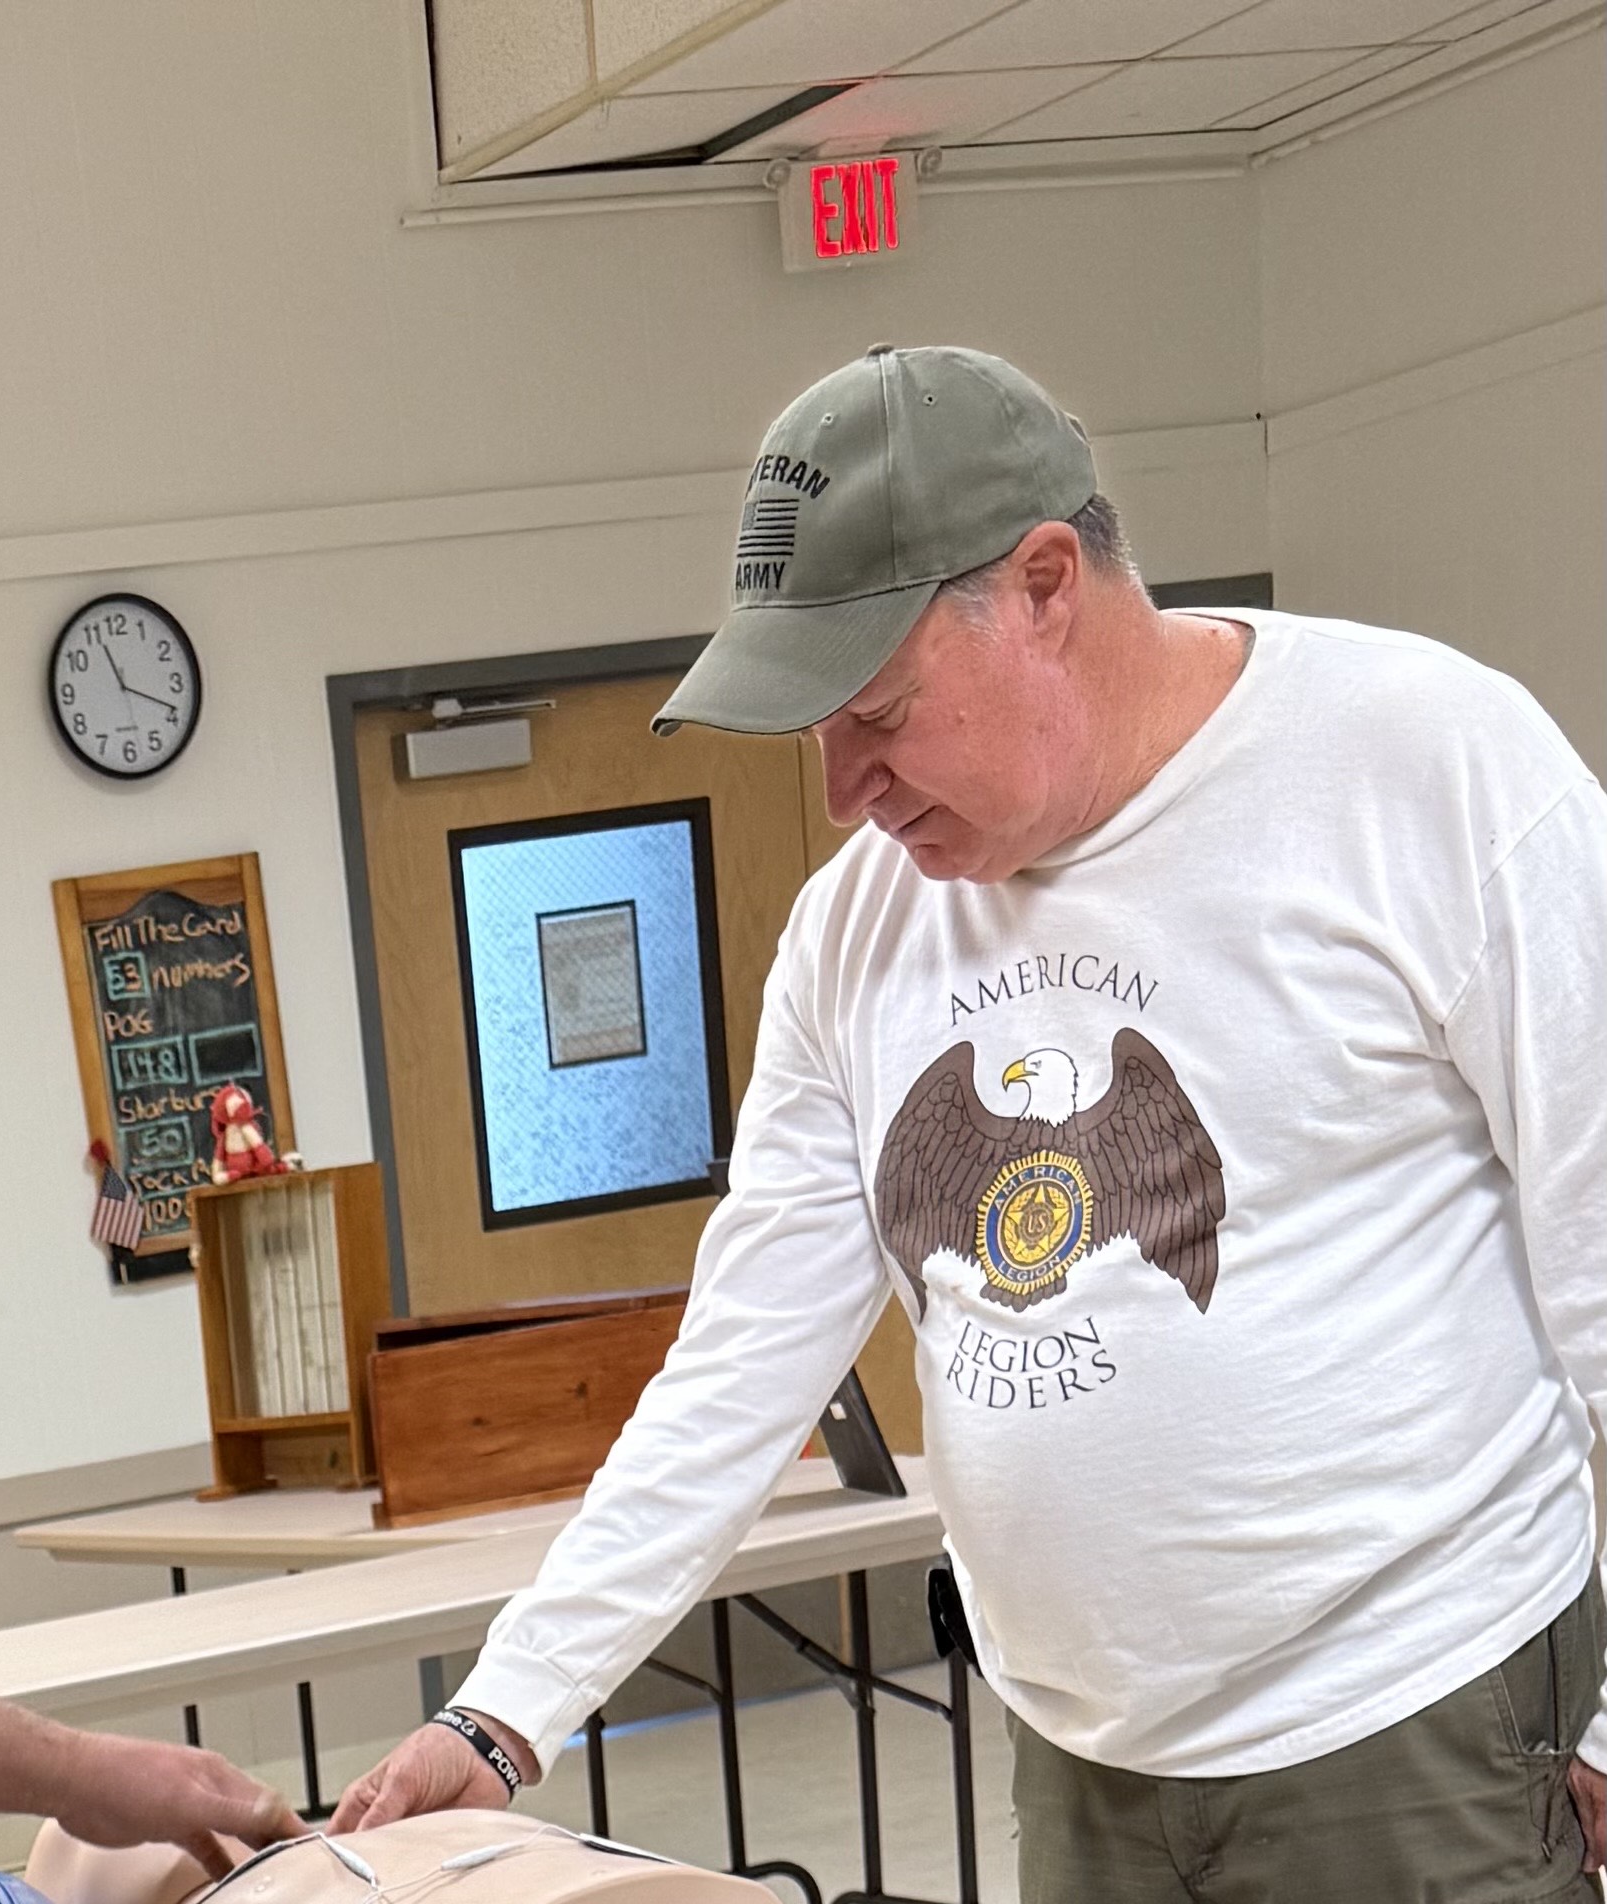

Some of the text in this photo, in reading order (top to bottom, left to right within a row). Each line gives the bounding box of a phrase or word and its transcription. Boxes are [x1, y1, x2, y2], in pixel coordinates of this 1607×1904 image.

[810, 158, 900, 258] EXIT
[735, 561, 785, 591] ARMY
[85, 623, 101, 645] 11
[104, 614, 128, 636] 12
[137, 620, 146, 640] 1
[67, 650, 88, 672] 10
[157, 640, 172, 662] 2
[169, 672, 183, 693] 3
[61, 683, 75, 705] 9
[73, 713, 87, 735] 8
[95, 734, 108, 755] 7
[123, 741, 137, 763] 6
[148, 731, 162, 751] 5
[95, 924, 134, 951] Fill
[182, 910, 242, 938] Card
[951, 953, 1159, 1027] AMERICAN
[141, 1127, 182, 1157] 50
[994, 1166, 1082, 1211] AMERICAN
[998, 1255, 1061, 1281] LEGION
[958, 1316, 1100, 1373] LEGION
[946, 1349, 1117, 1410] RIDERS
